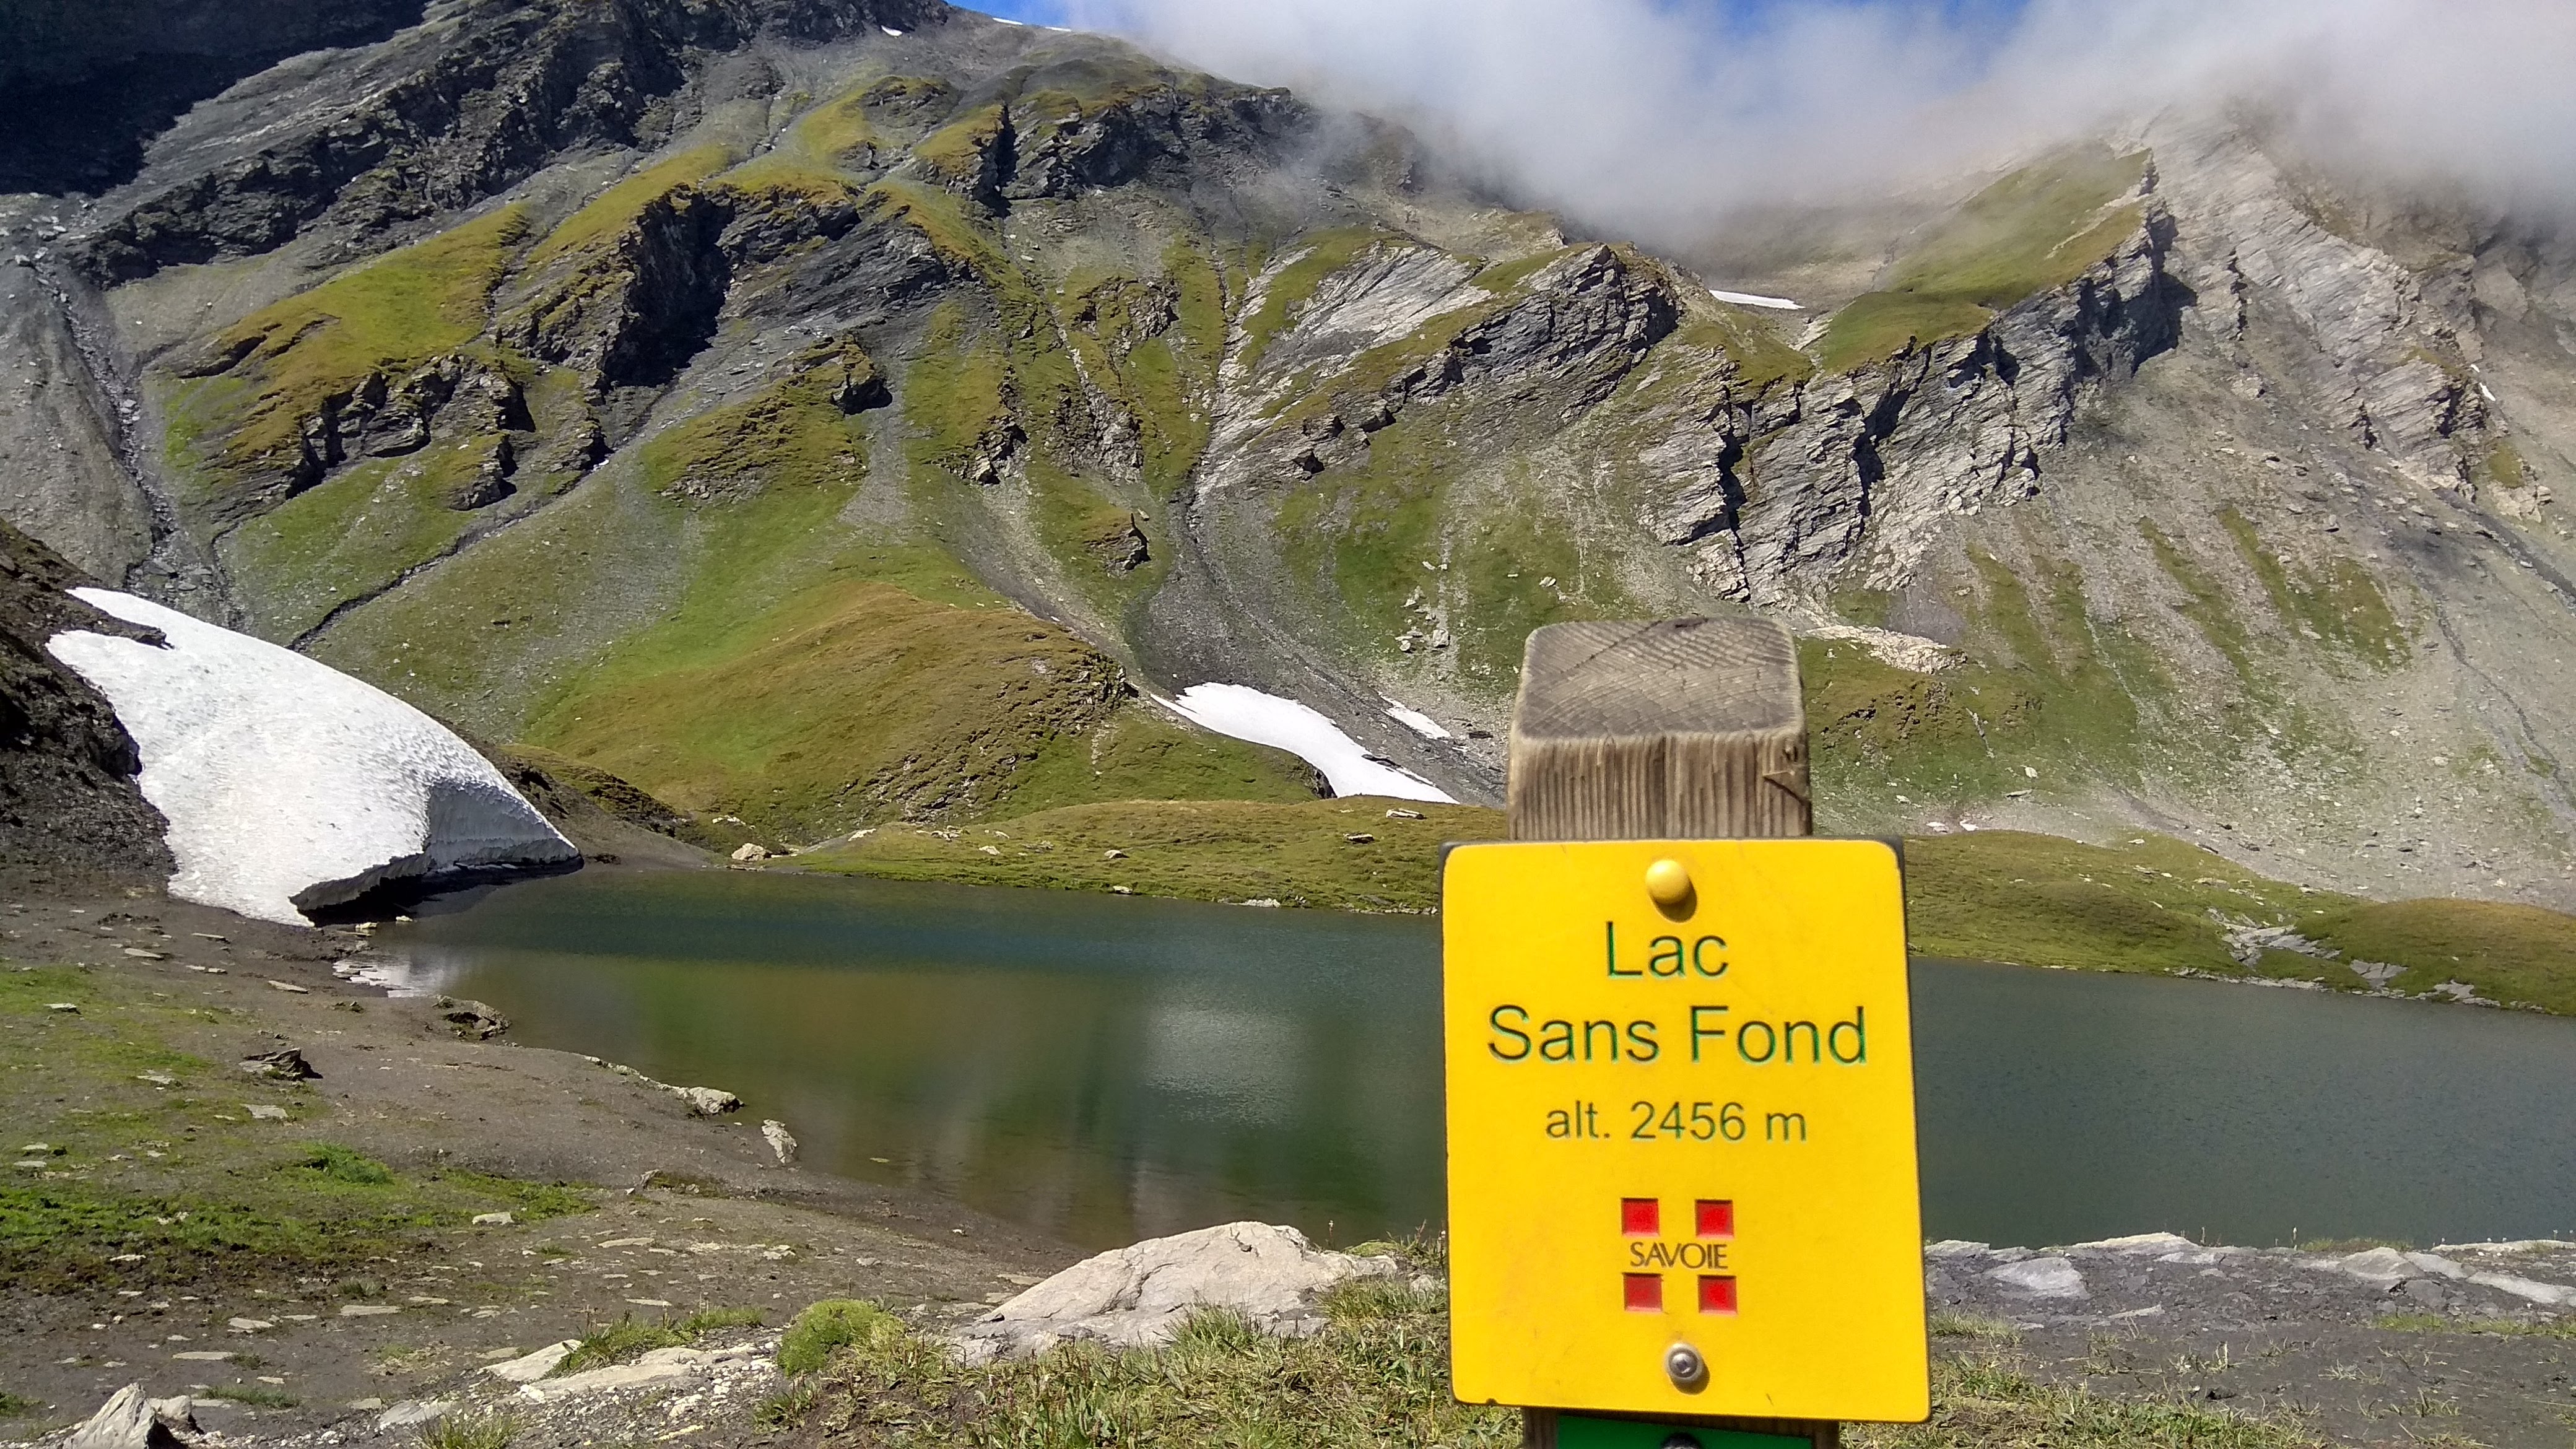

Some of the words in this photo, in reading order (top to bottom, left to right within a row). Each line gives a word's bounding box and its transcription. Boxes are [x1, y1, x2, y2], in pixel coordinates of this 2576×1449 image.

[1606, 921, 1728, 977] Lac
[1488, 1004, 1660, 1063] Sans
[1690, 1006, 1866, 1064] Fond
[1546, 1100, 1611, 1139] alt.
[1631, 1101, 1746, 1141] 2456
[1766, 1113, 1806, 1141] m
[1630, 1242, 1728, 1269] SAVOIE
